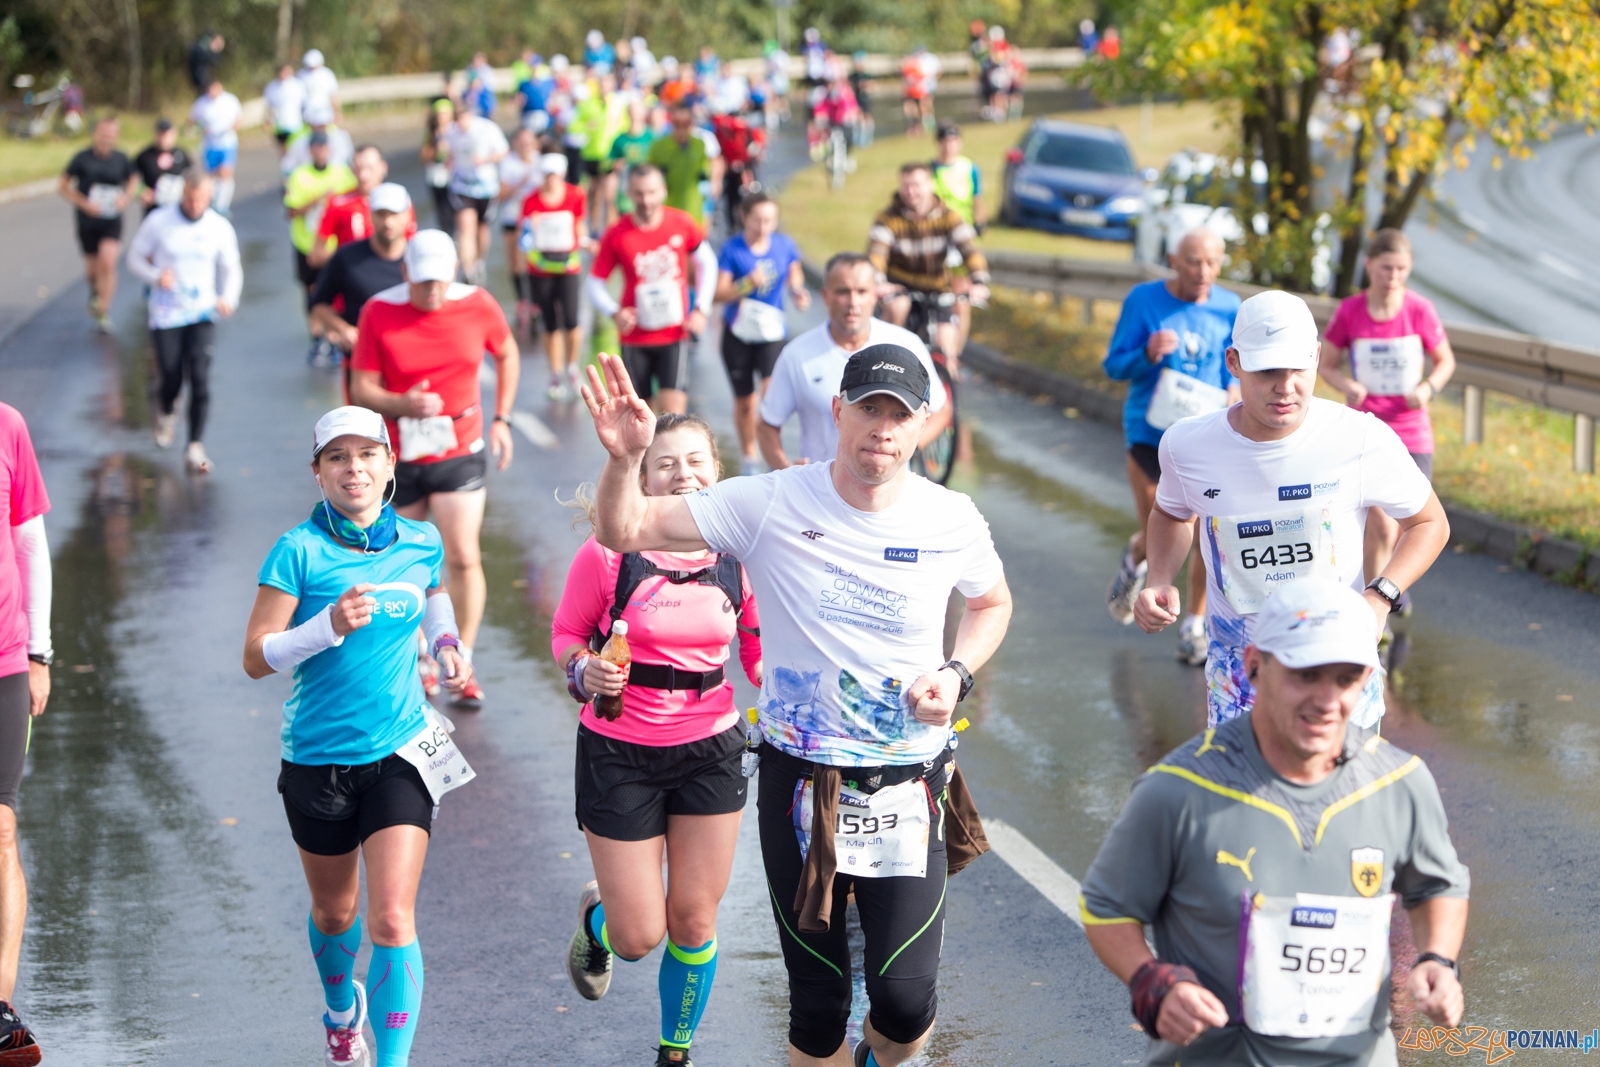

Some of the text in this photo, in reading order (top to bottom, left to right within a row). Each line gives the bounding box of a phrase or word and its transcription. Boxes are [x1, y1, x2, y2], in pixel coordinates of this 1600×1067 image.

[883, 363, 905, 374] asics
[1203, 489, 1221, 499] 4F
[801, 530, 824, 540] 4F
[1241, 543, 1313, 569] 6433
[825, 562, 859, 580] SIŁA
[1265, 571, 1295, 582] Adam
[834, 578, 908, 604] ODWAGA
[384, 600, 408, 613] SKY
[820, 589, 908, 619] SZYBKOŚĆ
[818, 611, 904, 634] 9 października 2016
[1280, 944, 1366, 974] 5692
